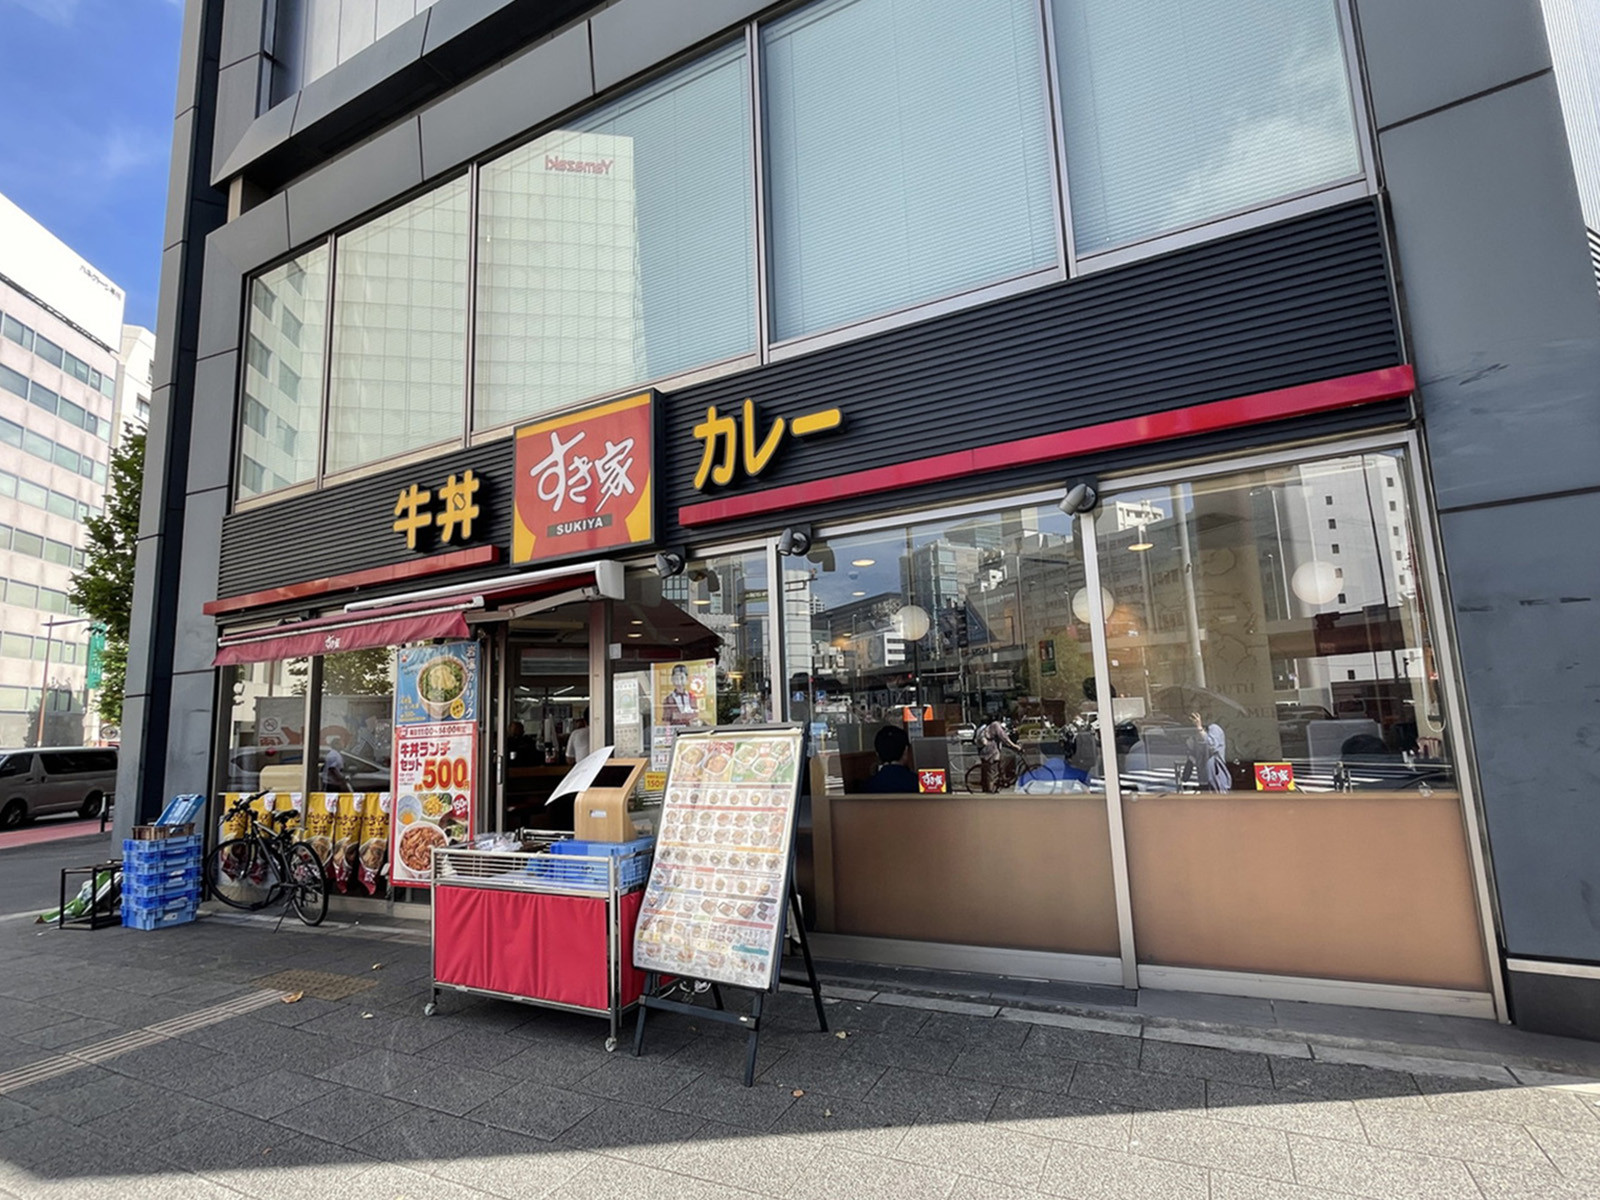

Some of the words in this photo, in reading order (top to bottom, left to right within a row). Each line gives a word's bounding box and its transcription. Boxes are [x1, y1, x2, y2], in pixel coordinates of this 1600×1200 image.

[693, 398, 842, 490] カレー
[530, 431, 635, 513] すき家
[393, 469, 480, 550] 牛丼
[556, 516, 604, 535] SUKIYA
[400, 740, 451, 758] 牛丼ランチ
[400, 759, 422, 771] セット
[1259, 765, 1290, 785] すき家
